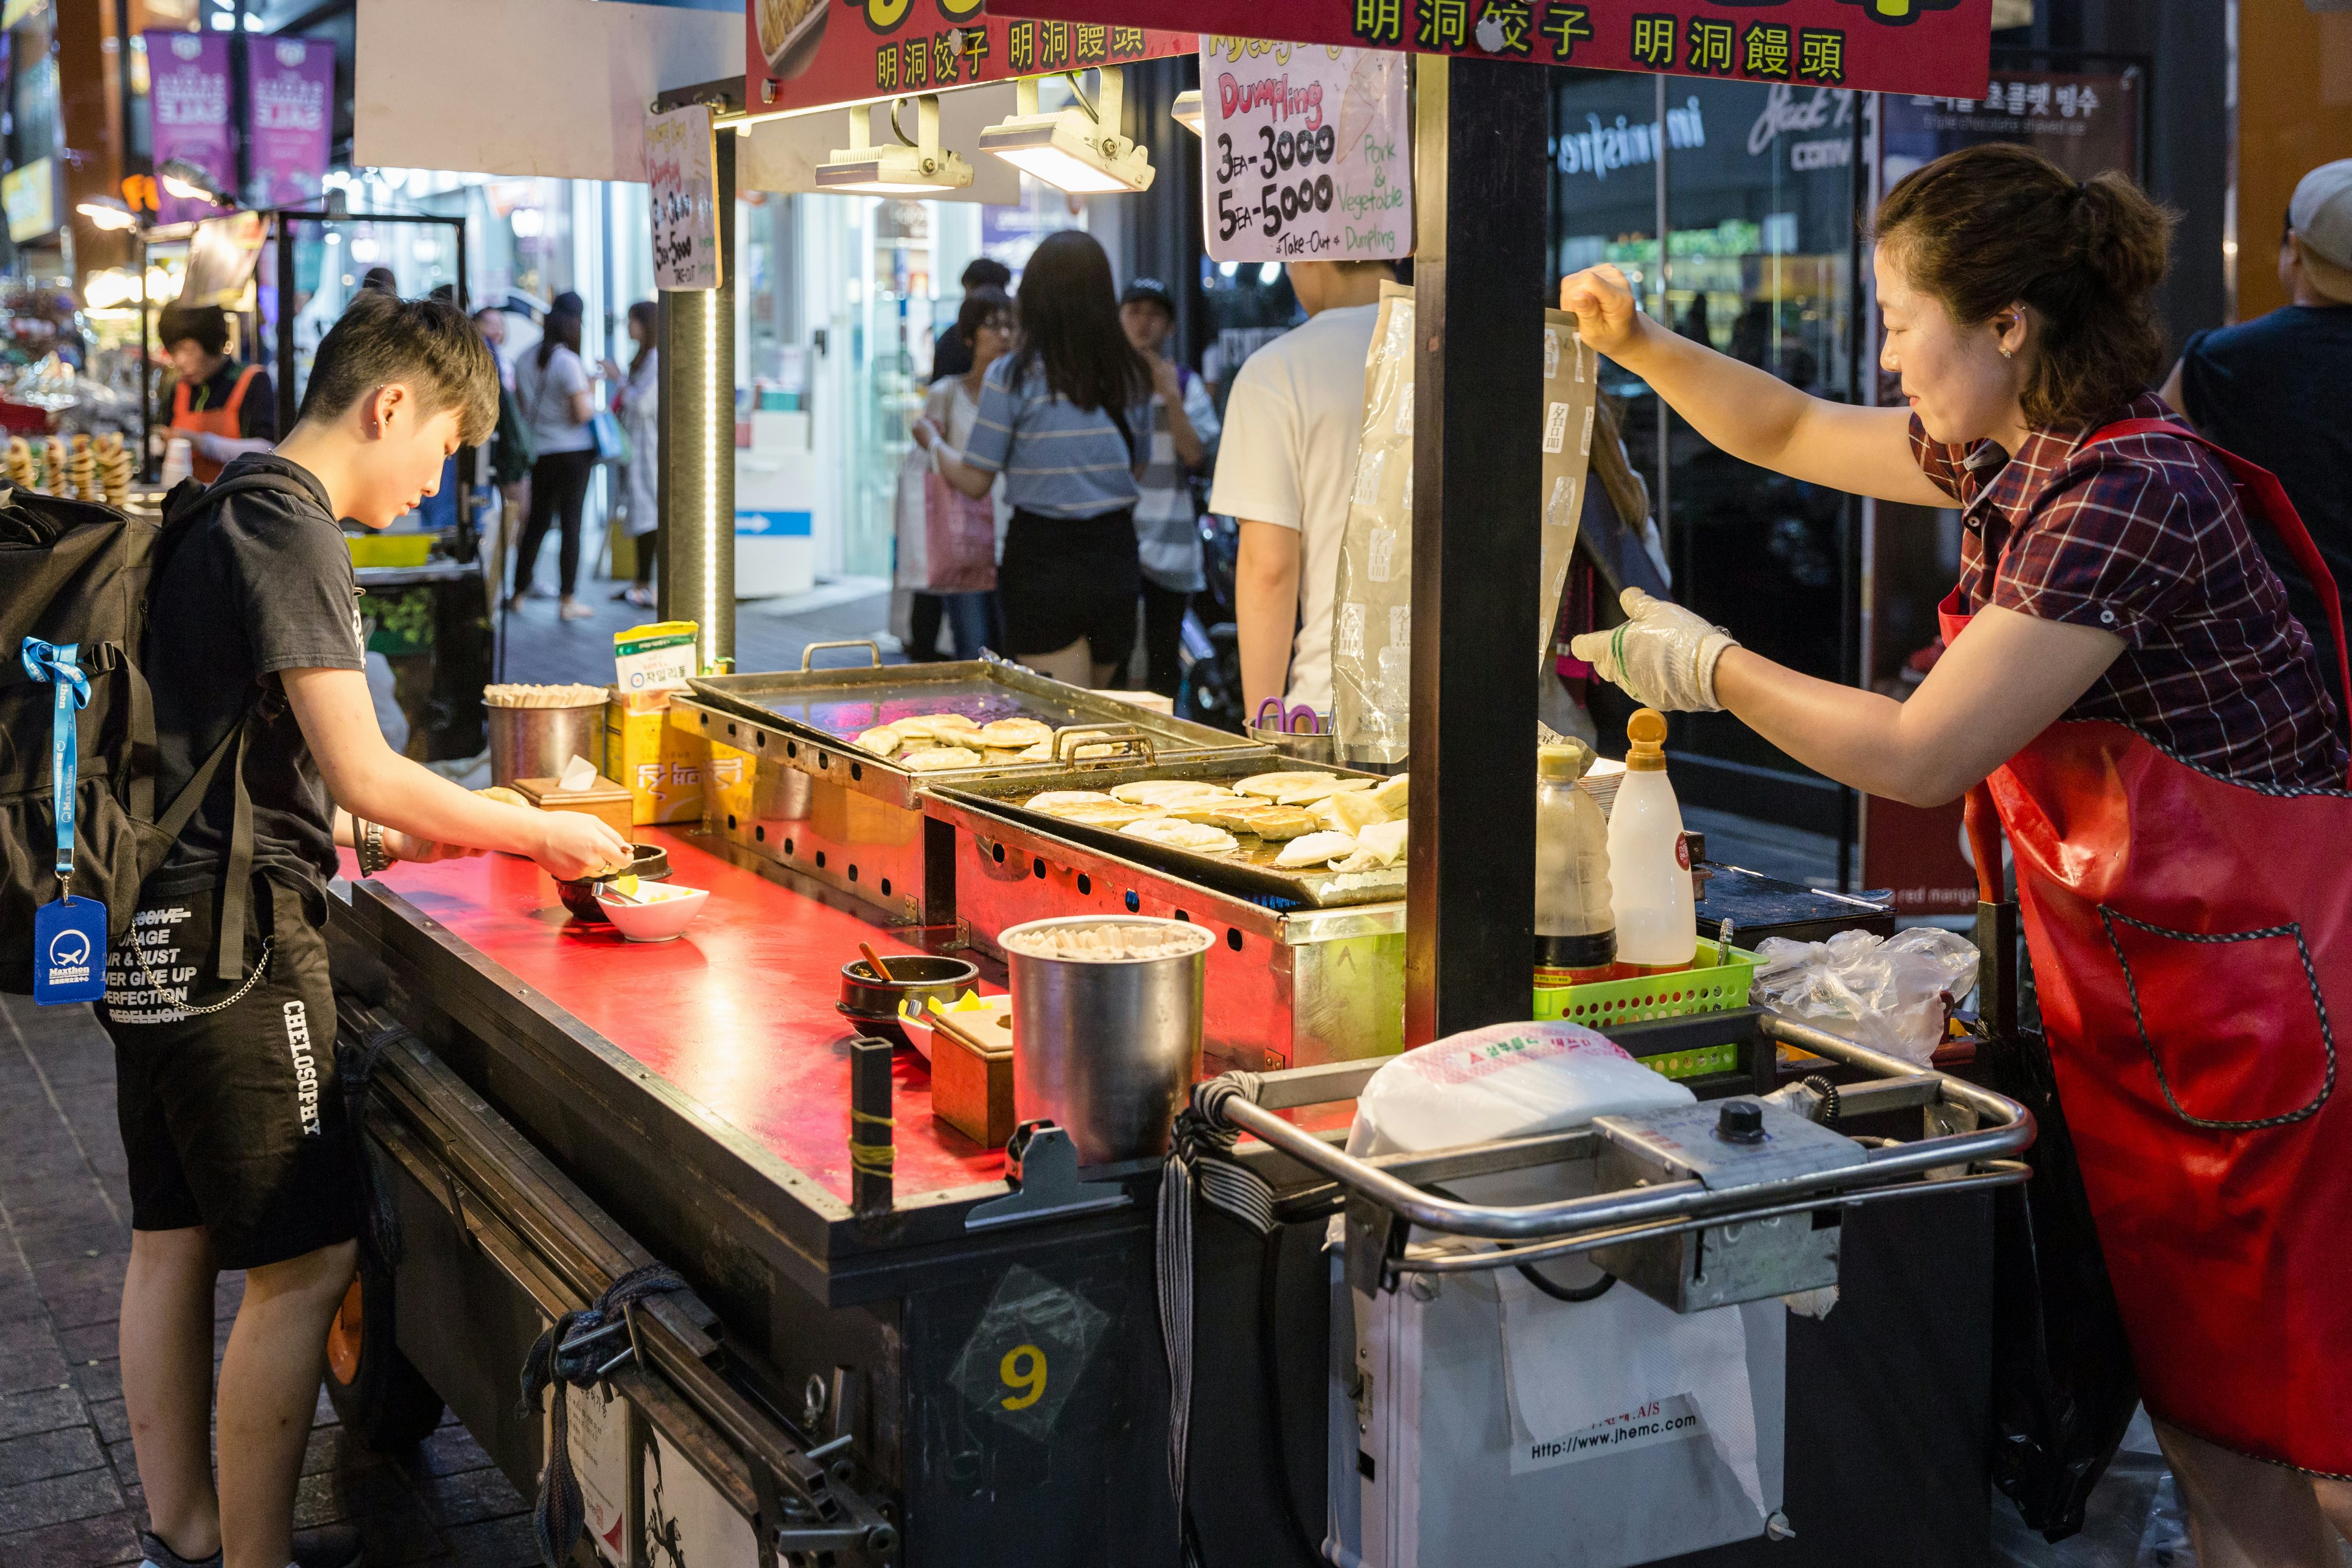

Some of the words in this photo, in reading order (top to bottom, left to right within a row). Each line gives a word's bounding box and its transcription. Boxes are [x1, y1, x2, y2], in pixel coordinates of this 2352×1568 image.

[1634, 19, 1842, 79] 明洞饅頭
[1218, 72, 1323, 131] Dumpling
[2056, 84, 2099, 117] 빙수
[1364, 133, 1396, 166] Pork
[1374, 166, 1388, 188] &
[1336, 184, 1404, 221] Vegetable
[1345, 224, 1395, 253] Dumpling
[63, 765, 74, 811] Maxthon
[49, 967, 89, 976] Maxthon
[106, 952, 121, 967] IR
[124, 952, 133, 967] &
[137, 948, 180, 965] JUST
[130, 969, 168, 987] GIVE
[172, 967, 197, 982] UP
[283, 1000, 321, 1135] CHELOSOPHY
[1000, 1344, 1047, 1411] 9
[1531, 1415, 1696, 1459] Http://www.jhemc.com
